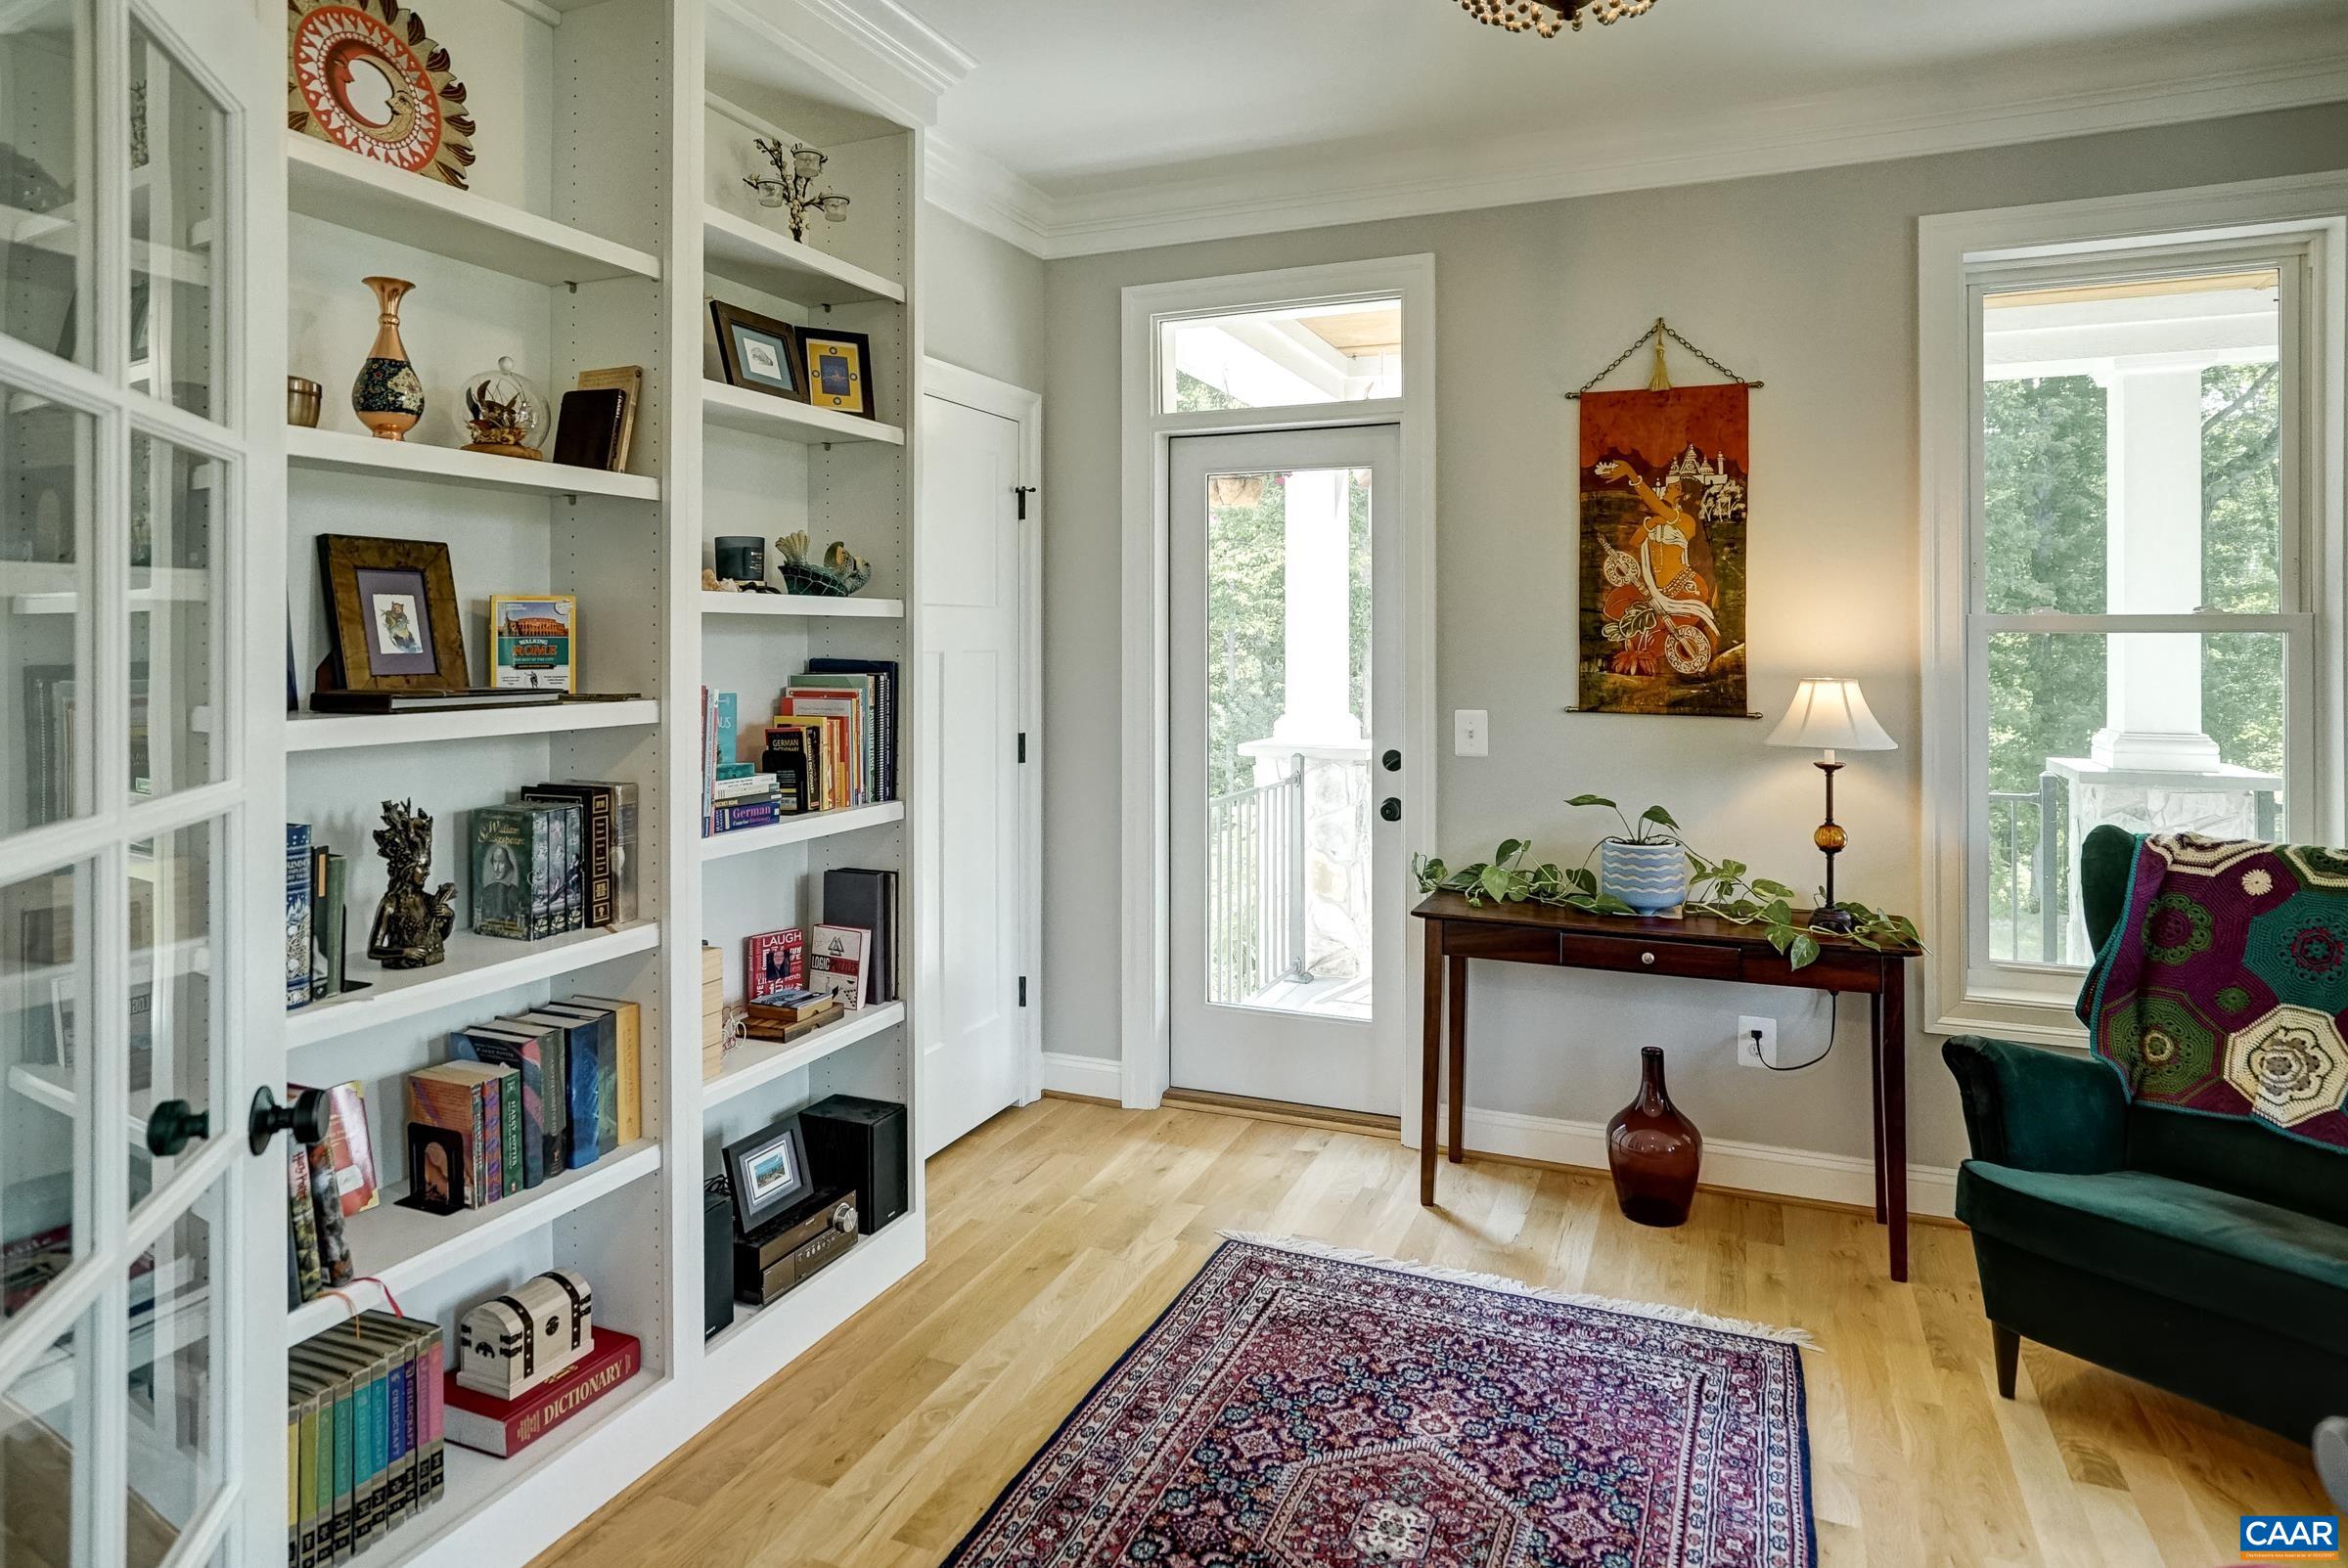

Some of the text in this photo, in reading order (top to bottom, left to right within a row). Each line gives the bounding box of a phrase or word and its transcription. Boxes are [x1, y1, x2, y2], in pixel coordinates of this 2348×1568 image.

[772, 739, 799, 747] GERMAN
[733, 806, 771, 819] German
[487, 820, 519, 834] William
[762, 931, 802, 948] LAUGH
[811, 956, 831, 971] LOGIC
[543, 1360, 623, 1425] DICTIONARY
[391, 1389, 400, 1456] CHILDCRAFT
